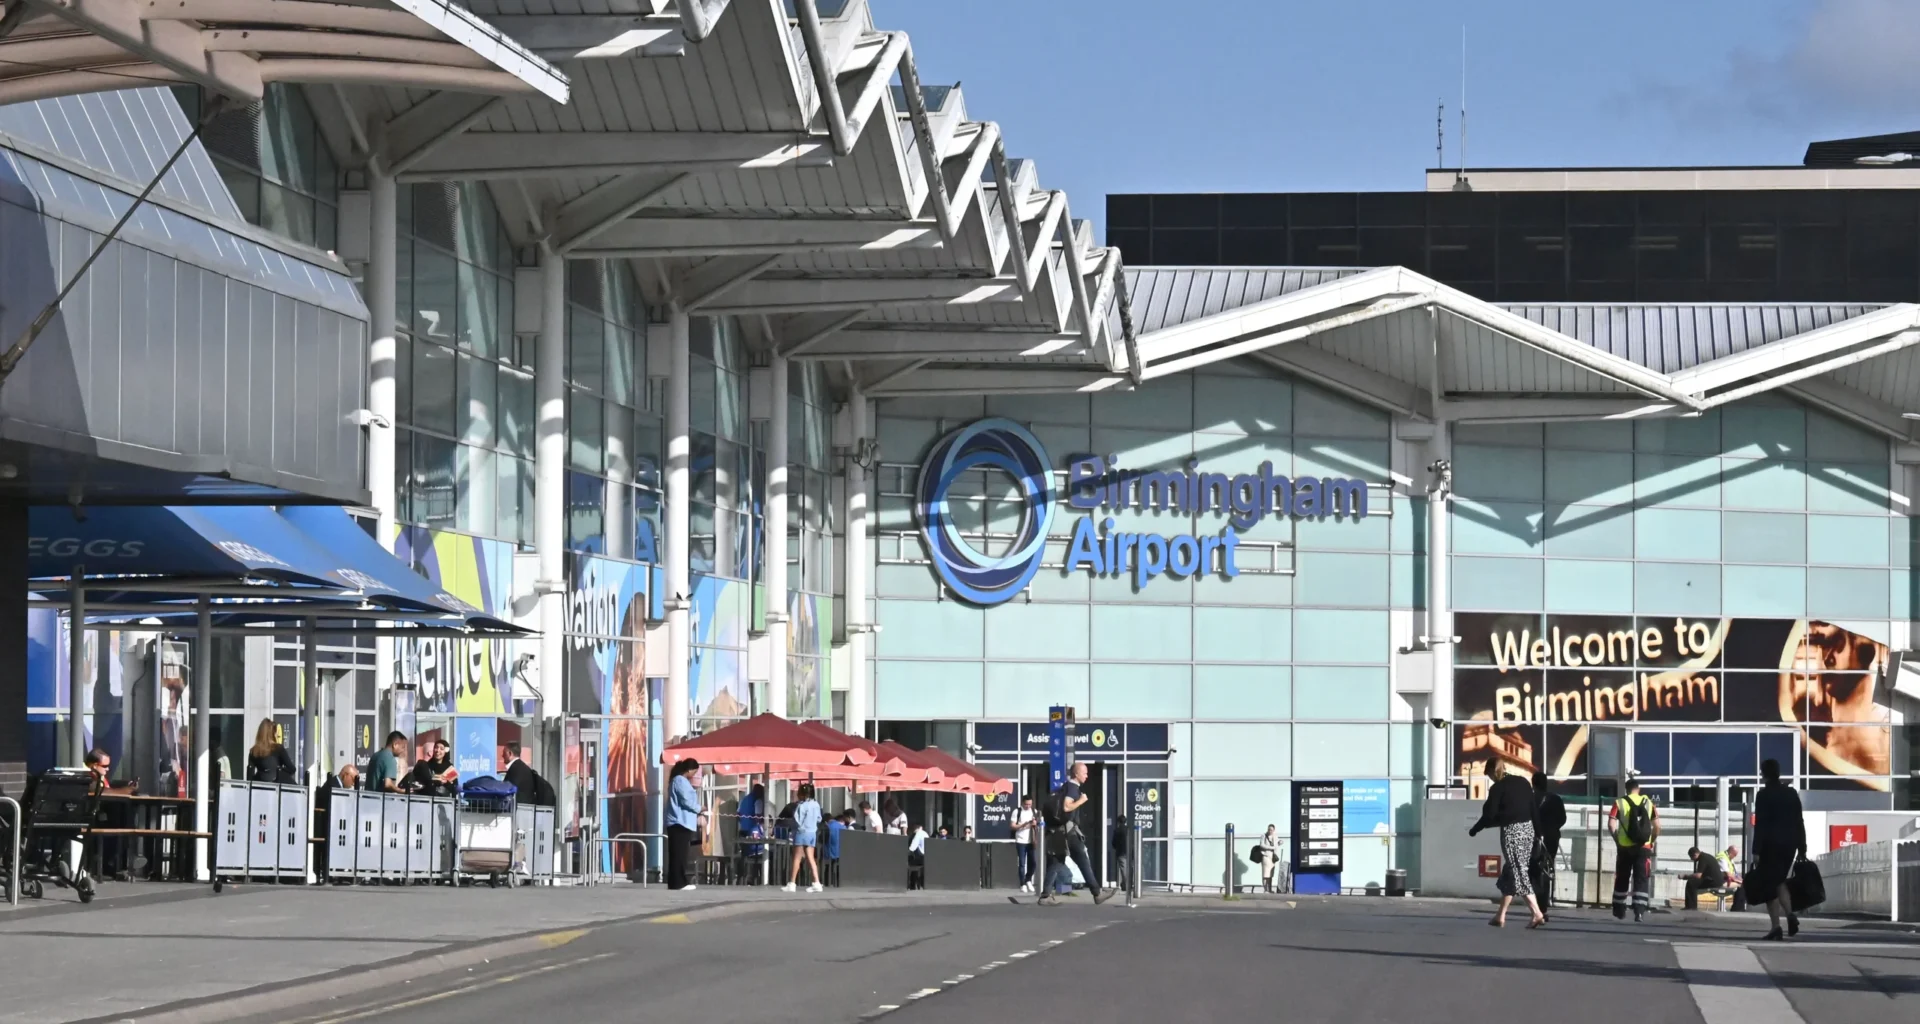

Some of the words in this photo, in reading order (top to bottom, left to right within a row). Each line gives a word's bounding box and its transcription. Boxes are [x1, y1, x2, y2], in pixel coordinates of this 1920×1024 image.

[1069, 454, 1368, 528] Birmingham
[1067, 516, 1240, 588] Airport
[1490, 625, 1663, 673] Welcome
[1674, 617, 1711, 656] to
[1495, 672, 1718, 728] Birmingham
[983, 804, 1011, 813] Check-in
[983, 813, 999, 821] Zone
[1000, 813, 1006, 821] A
[1134, 804, 1161, 812] Check-in
[1134, 812, 1153, 820] Zones
